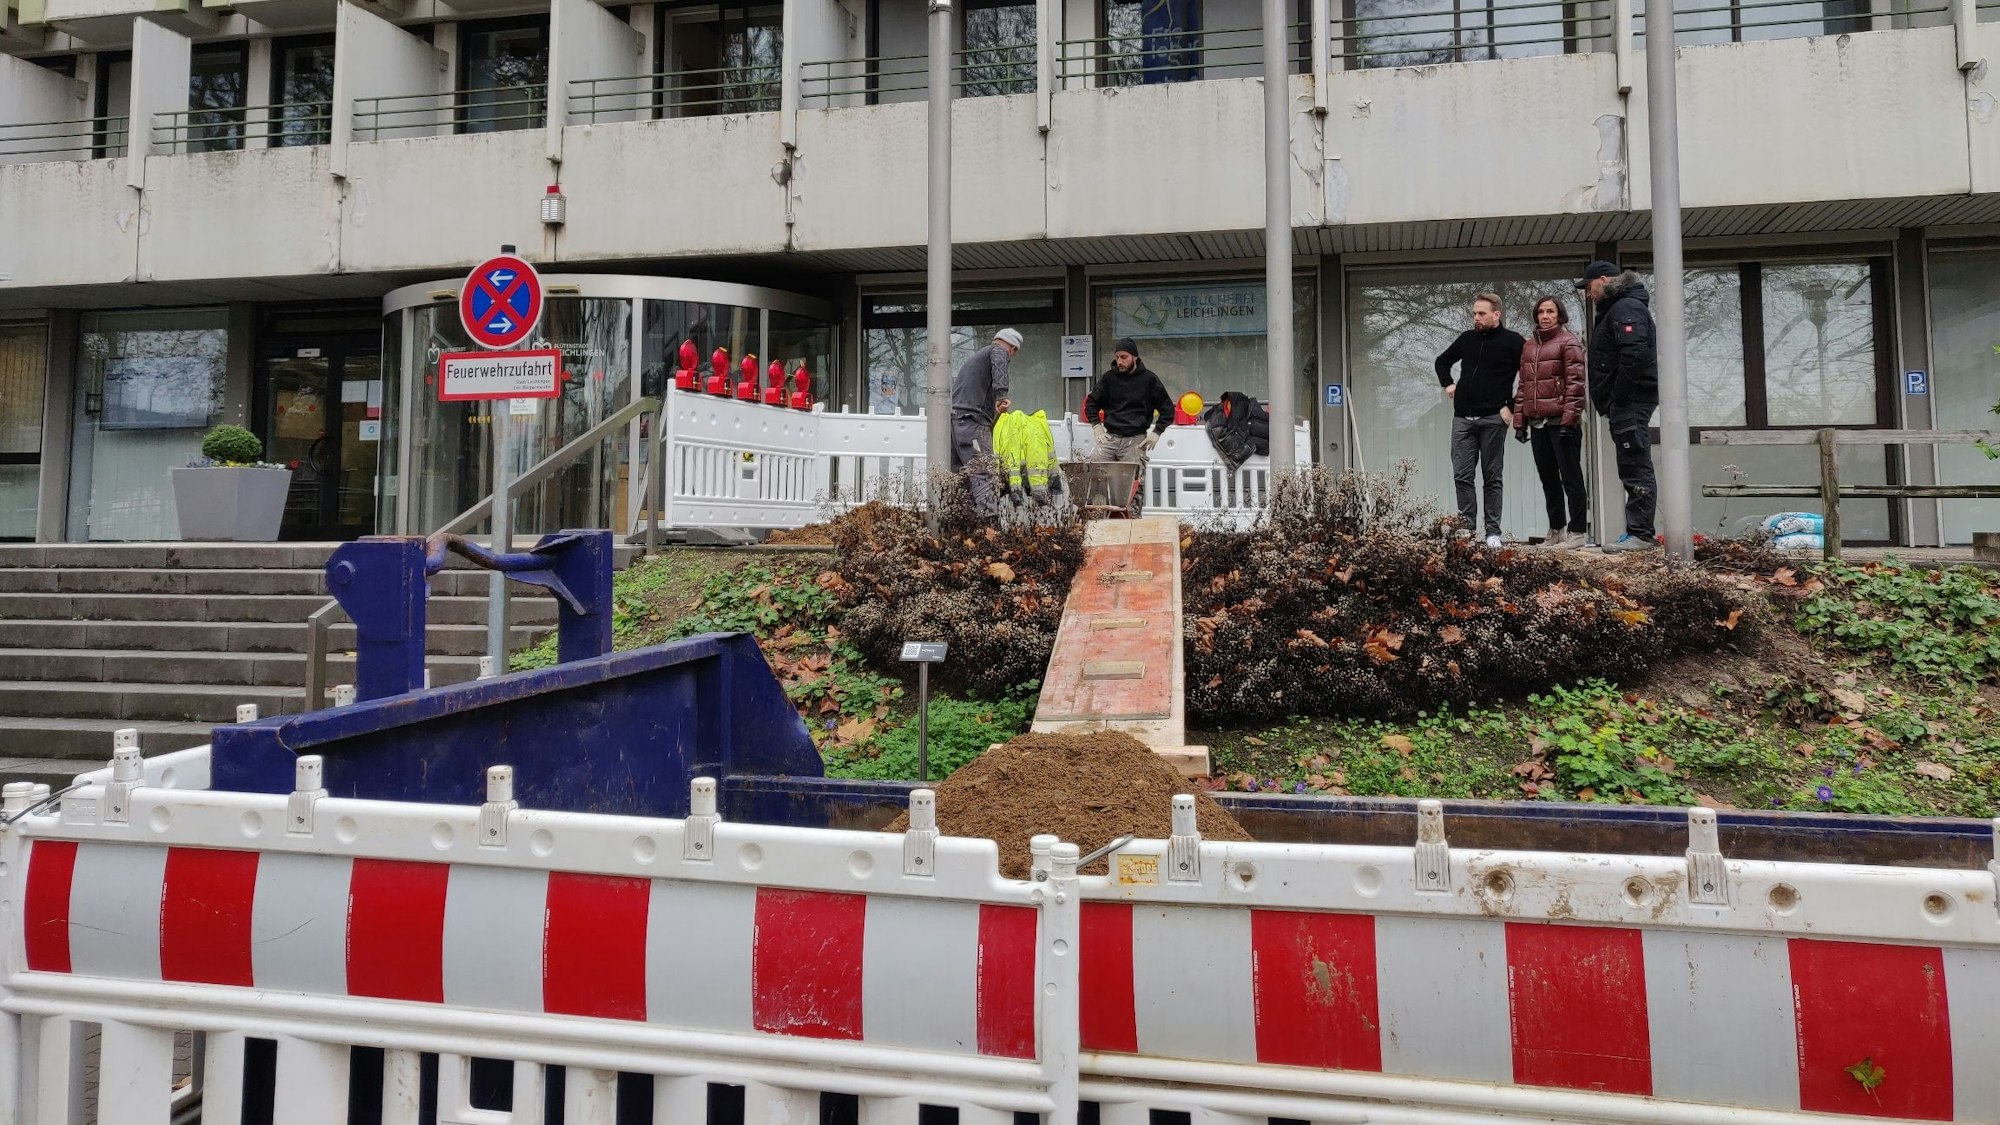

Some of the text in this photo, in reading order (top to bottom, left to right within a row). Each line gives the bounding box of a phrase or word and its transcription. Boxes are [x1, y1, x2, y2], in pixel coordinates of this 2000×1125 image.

[1176, 305, 1254, 318] LEICHLINGEN
[560, 348, 605, 356] EICHLINGEN
[447, 361, 552, 379] Feuerwehrzufahrt
